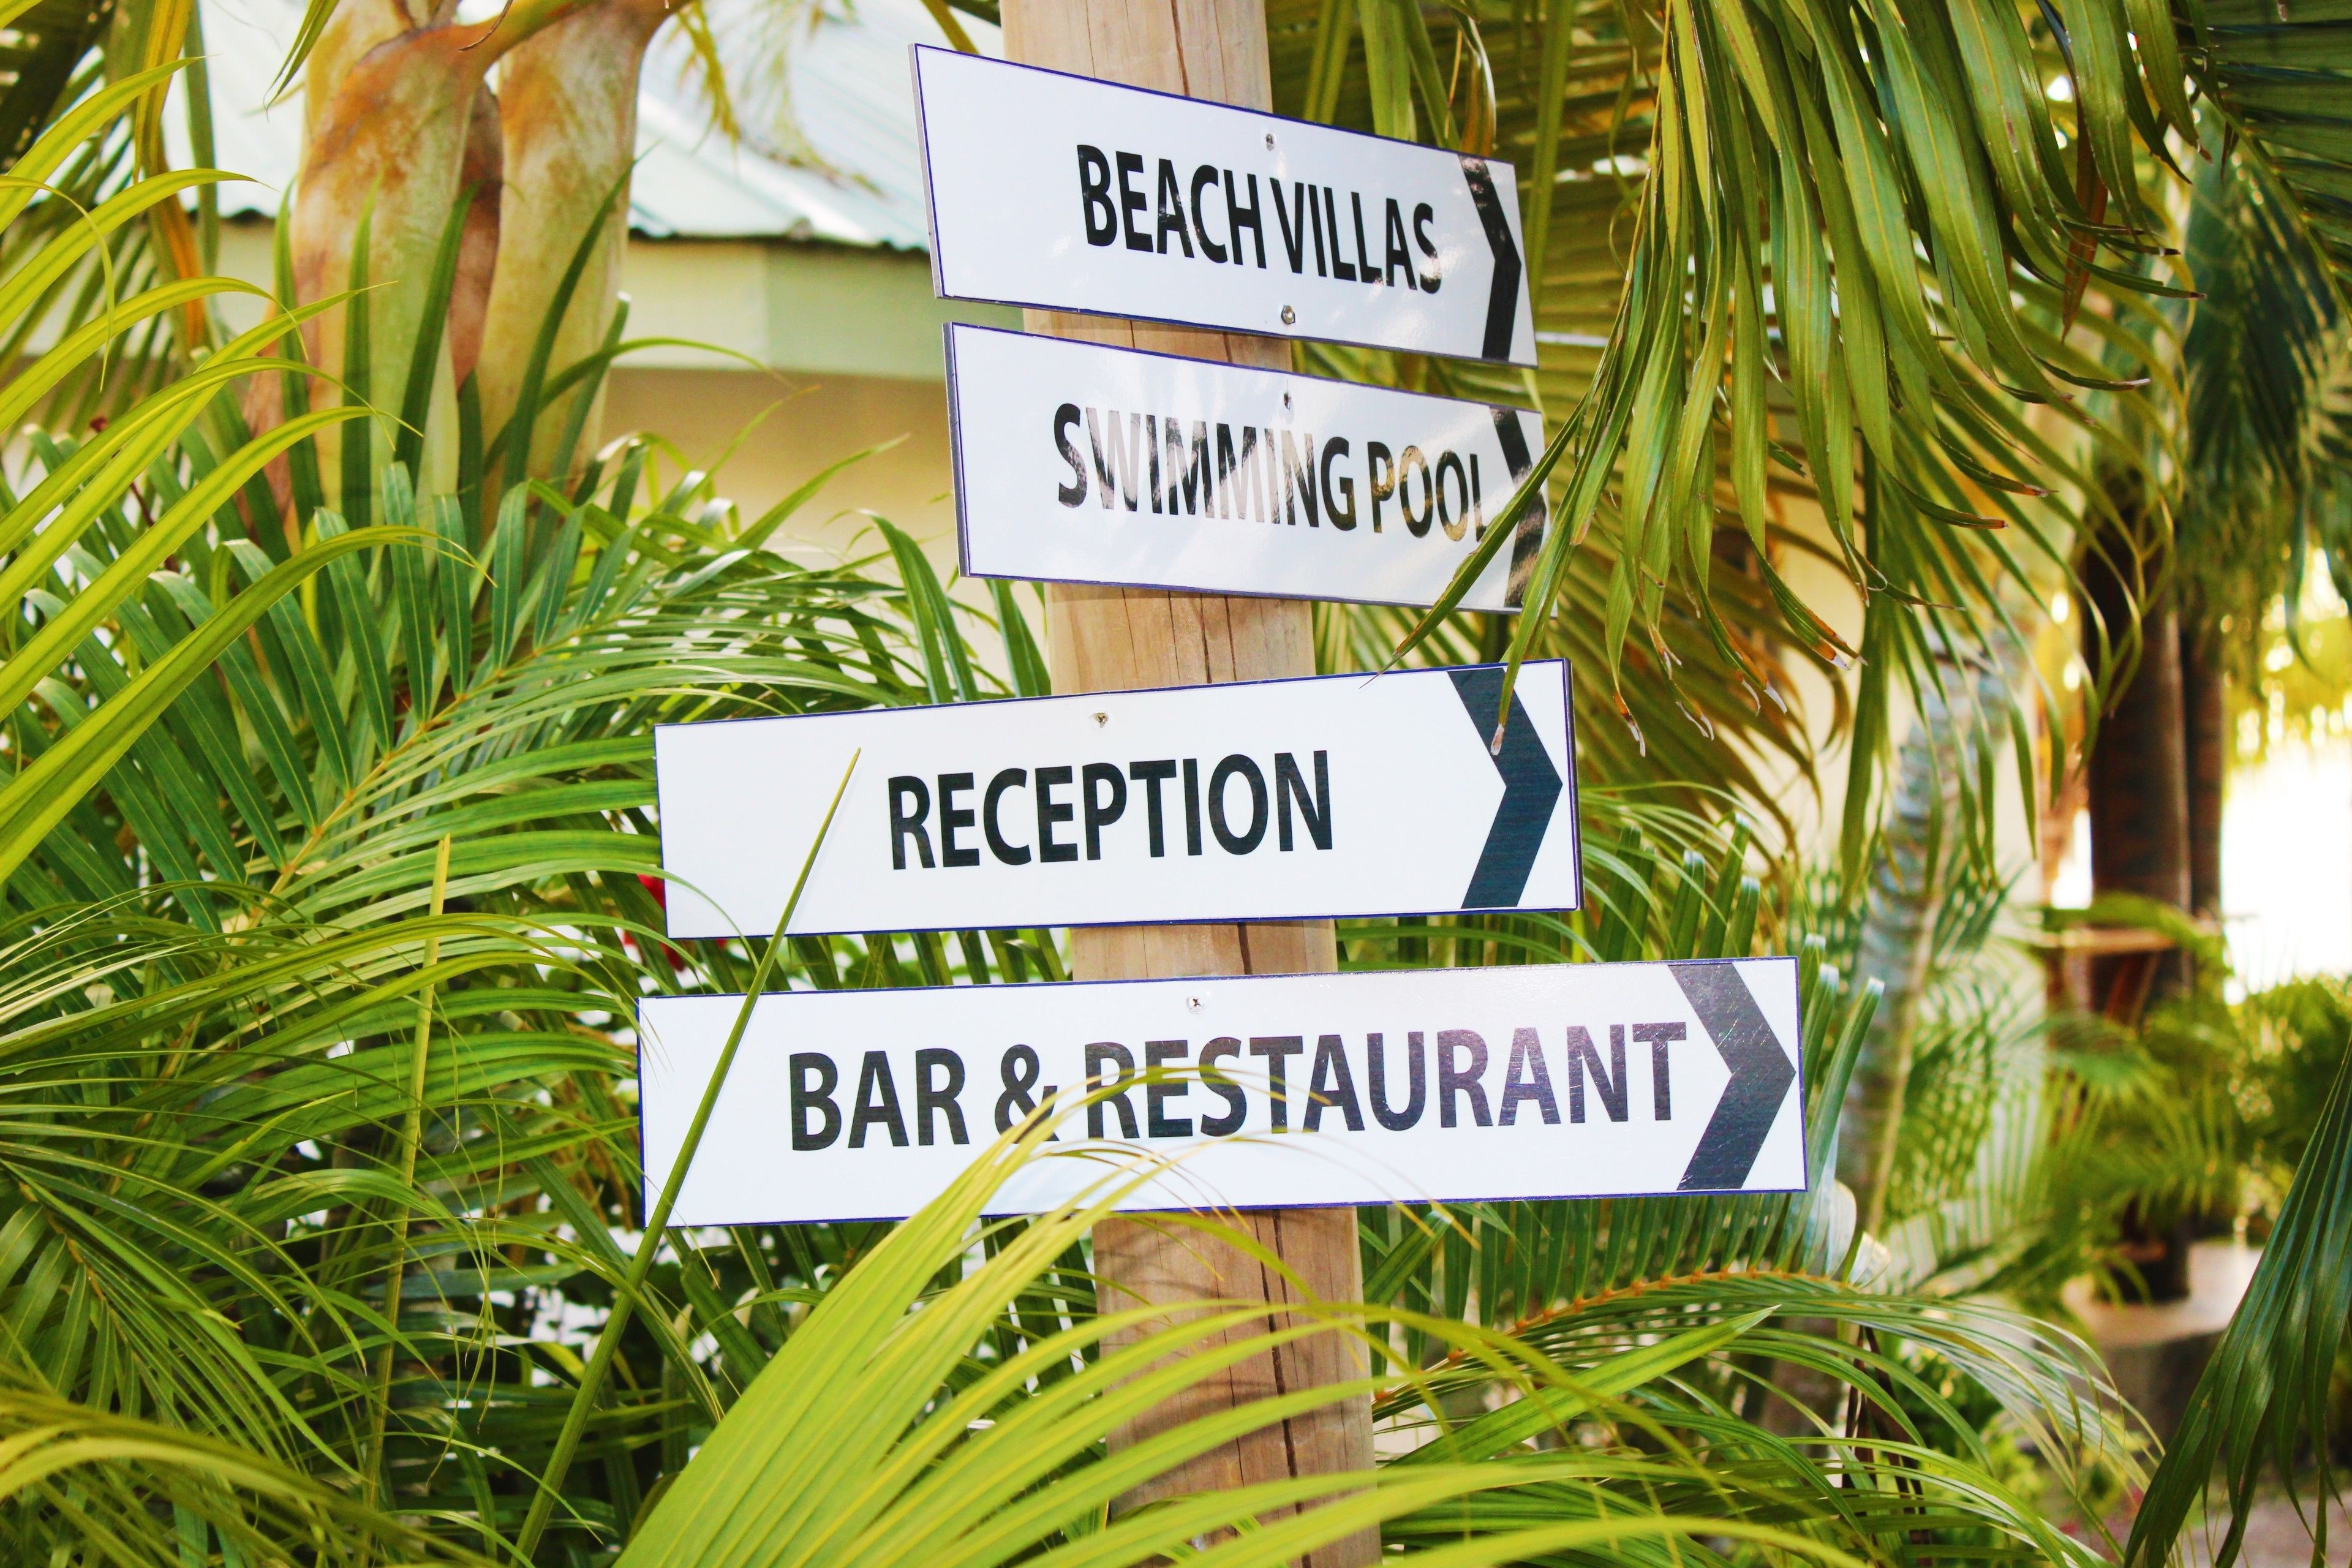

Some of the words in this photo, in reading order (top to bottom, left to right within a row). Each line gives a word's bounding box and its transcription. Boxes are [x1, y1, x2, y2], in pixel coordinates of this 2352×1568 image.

[1076, 144, 1267, 270] BEACH
[1270, 177, 1442, 295] VILLAS
[1053, 402, 1358, 532] SWIMMING
[1367, 441, 1489, 543] POOL
[888, 749, 1333, 871] RECEPTION
[789, 1047, 970, 1152] BAR
[994, 1044, 1059, 1145] &
[1084, 1022, 1687, 1140] RESTAURANT
